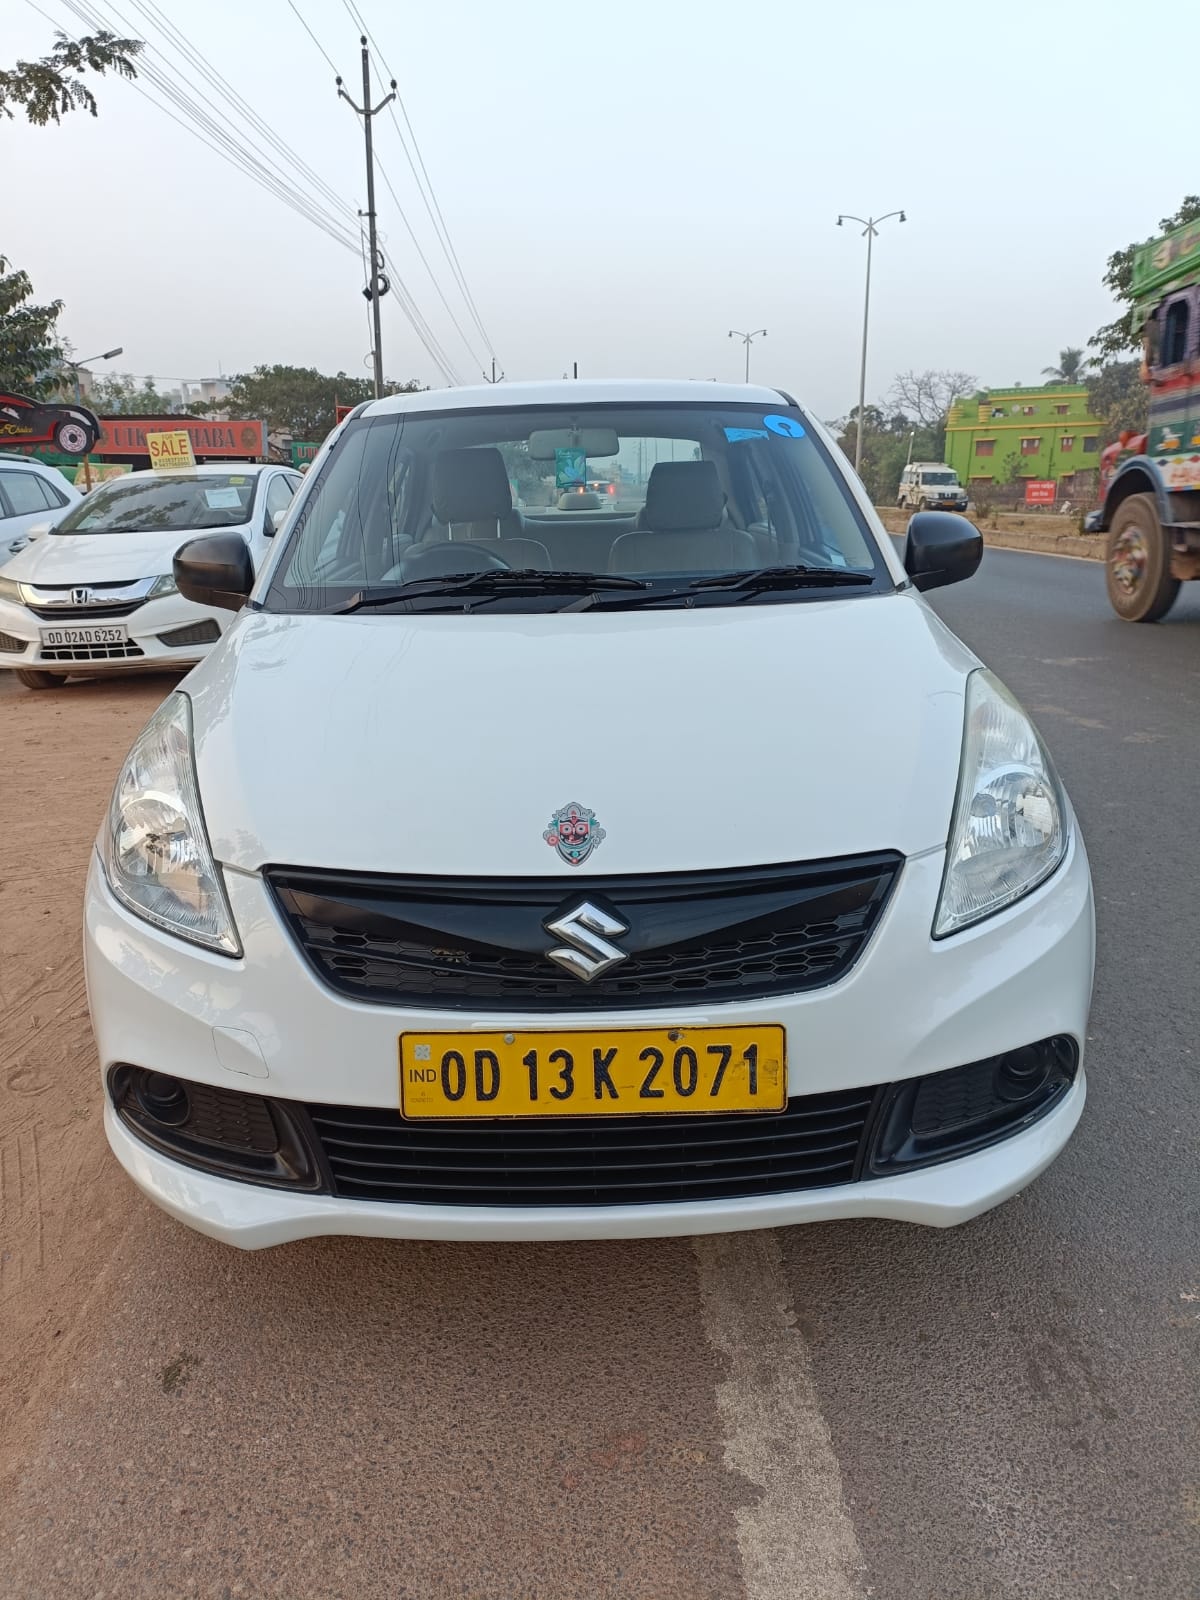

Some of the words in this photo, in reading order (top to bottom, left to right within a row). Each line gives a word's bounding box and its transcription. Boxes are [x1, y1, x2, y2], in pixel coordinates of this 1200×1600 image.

[150, 439, 189, 457] SALE
[48, 632, 63, 644] OD
[64, 631, 92, 643] 02AD
[94, 630, 122, 642] 6252
[409, 1069, 437, 1083] IND
[441, 1049, 500, 1101] OD
[522, 1049, 574, 1101] 13
[593, 1047, 619, 1099] K
[638, 1043, 758, 1098] 2071
